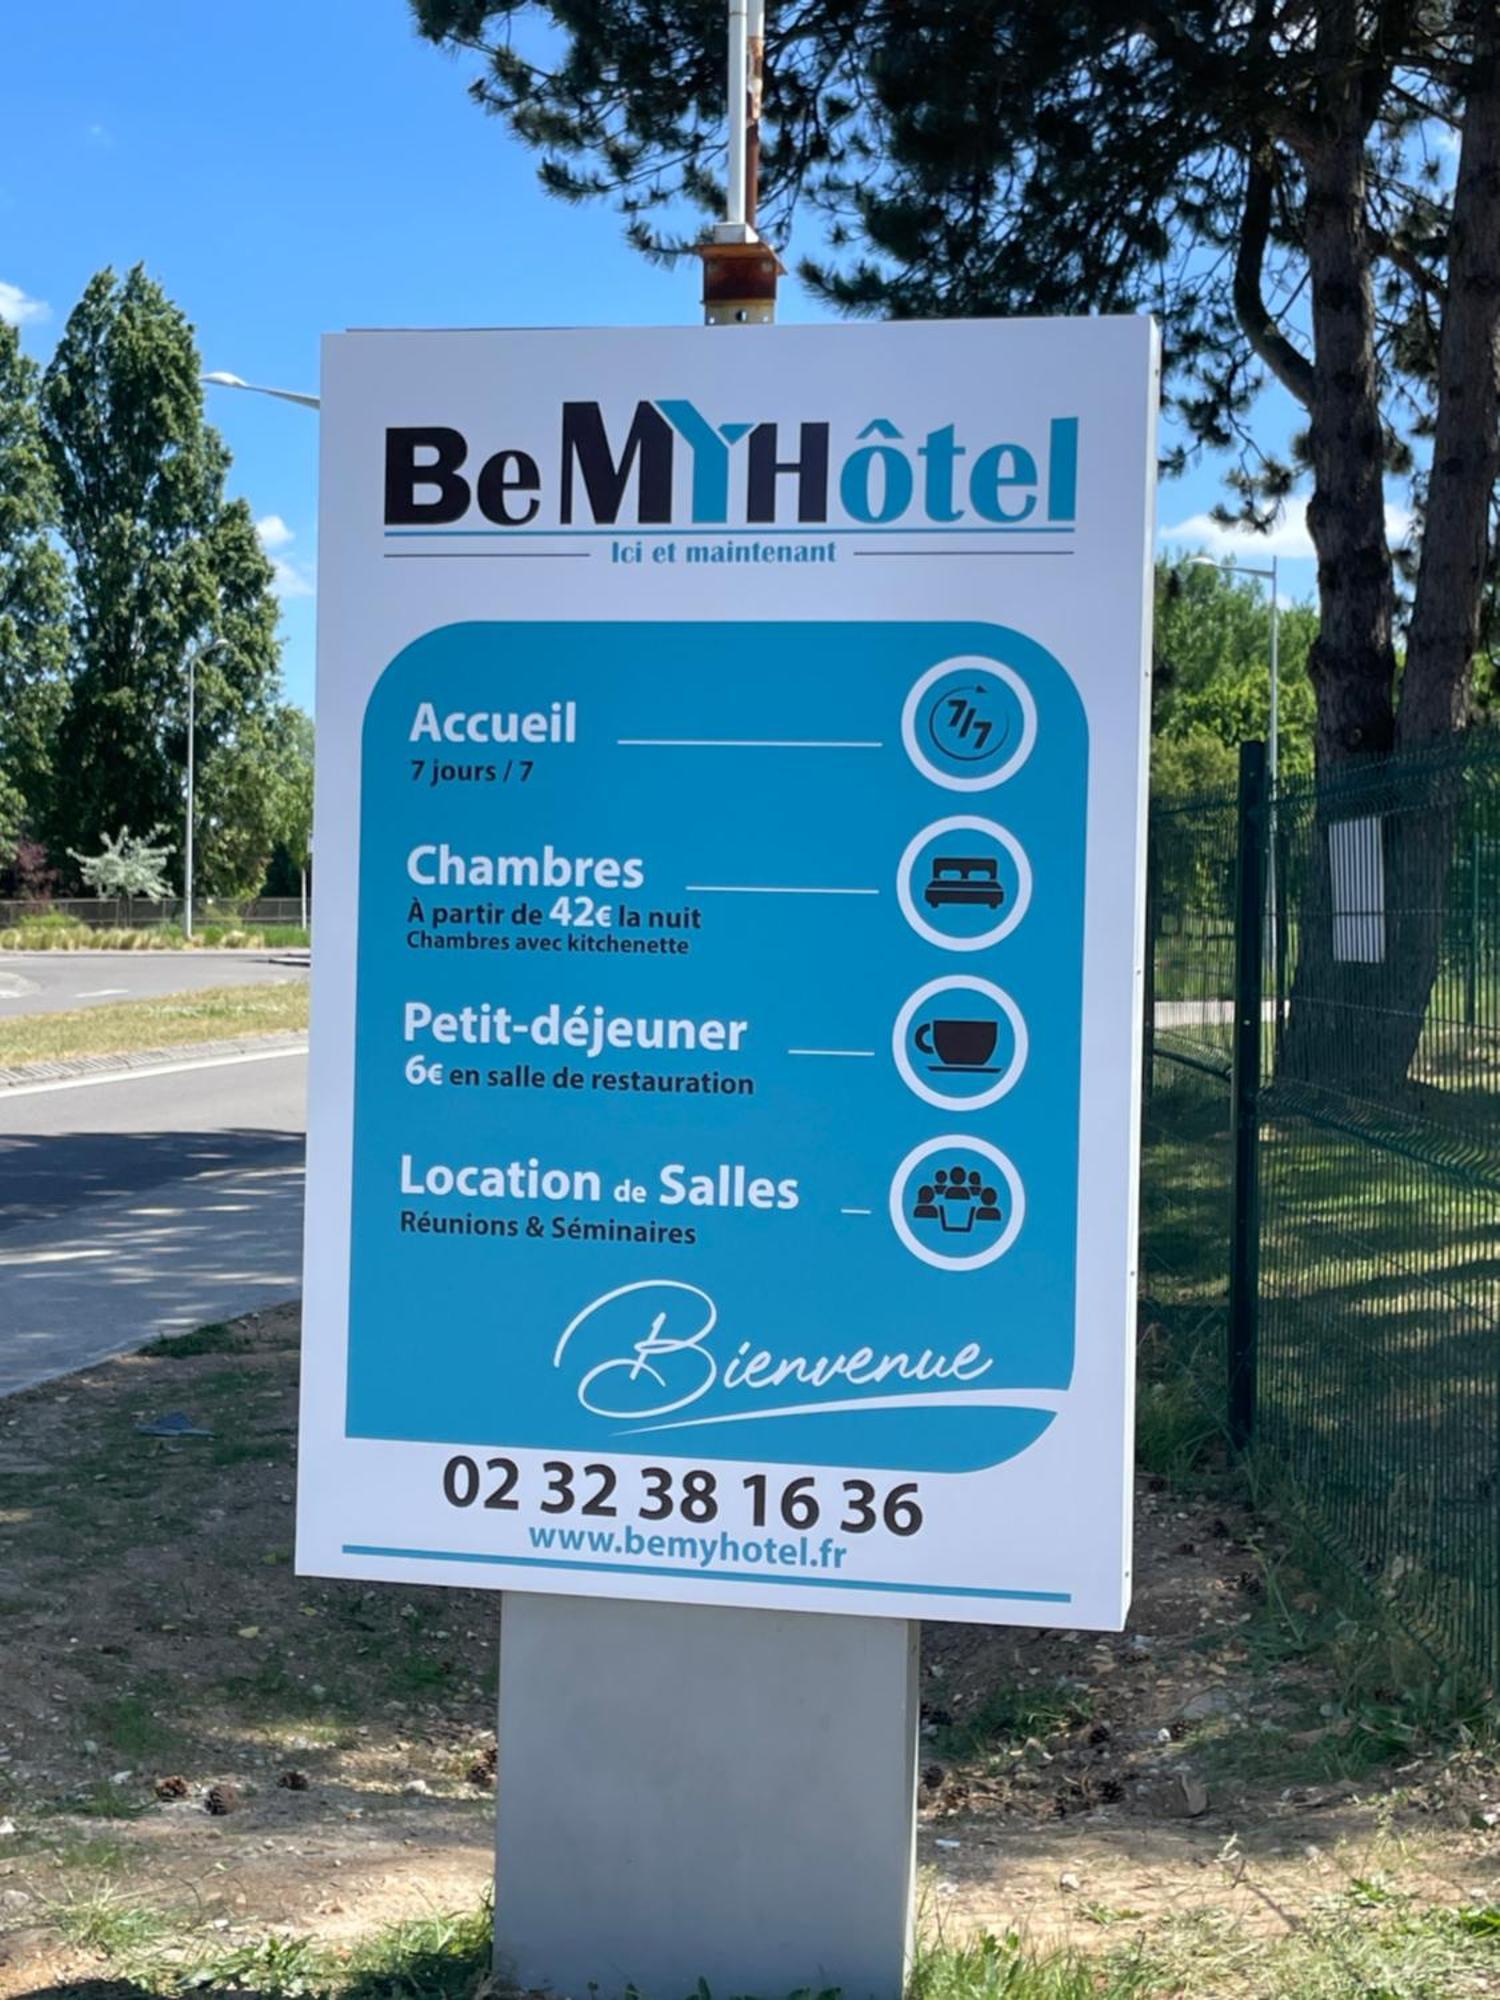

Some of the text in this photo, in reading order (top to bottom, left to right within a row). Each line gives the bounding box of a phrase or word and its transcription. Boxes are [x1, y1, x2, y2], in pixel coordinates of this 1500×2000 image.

[612, 541, 837, 564] Ici et maintenant
[408, 700, 577, 743] Accueil
[411, 759, 426, 782] 7
[430, 759, 497, 787] jours
[519, 760, 534, 782] 7
[406, 843, 645, 889] Chambres
[407, 895, 702, 930] À partir de 42€ la nuit
[406, 930, 690, 954] Chambres avec kitchenette
[403, 1001, 749, 1058] Petit-déjeuner
[404, 1054, 755, 1095] 6€ en salle de restauration
[400, 1154, 800, 1210] Location de Salles
[401, 1210, 697, 1245] Réunions & Séminaires
[553, 1278, 994, 1420] Bienvenue
[442, 1454, 924, 1537] 02 32 38 16 36
[528, 1524, 848, 1569] www.bemyhotel.fr
